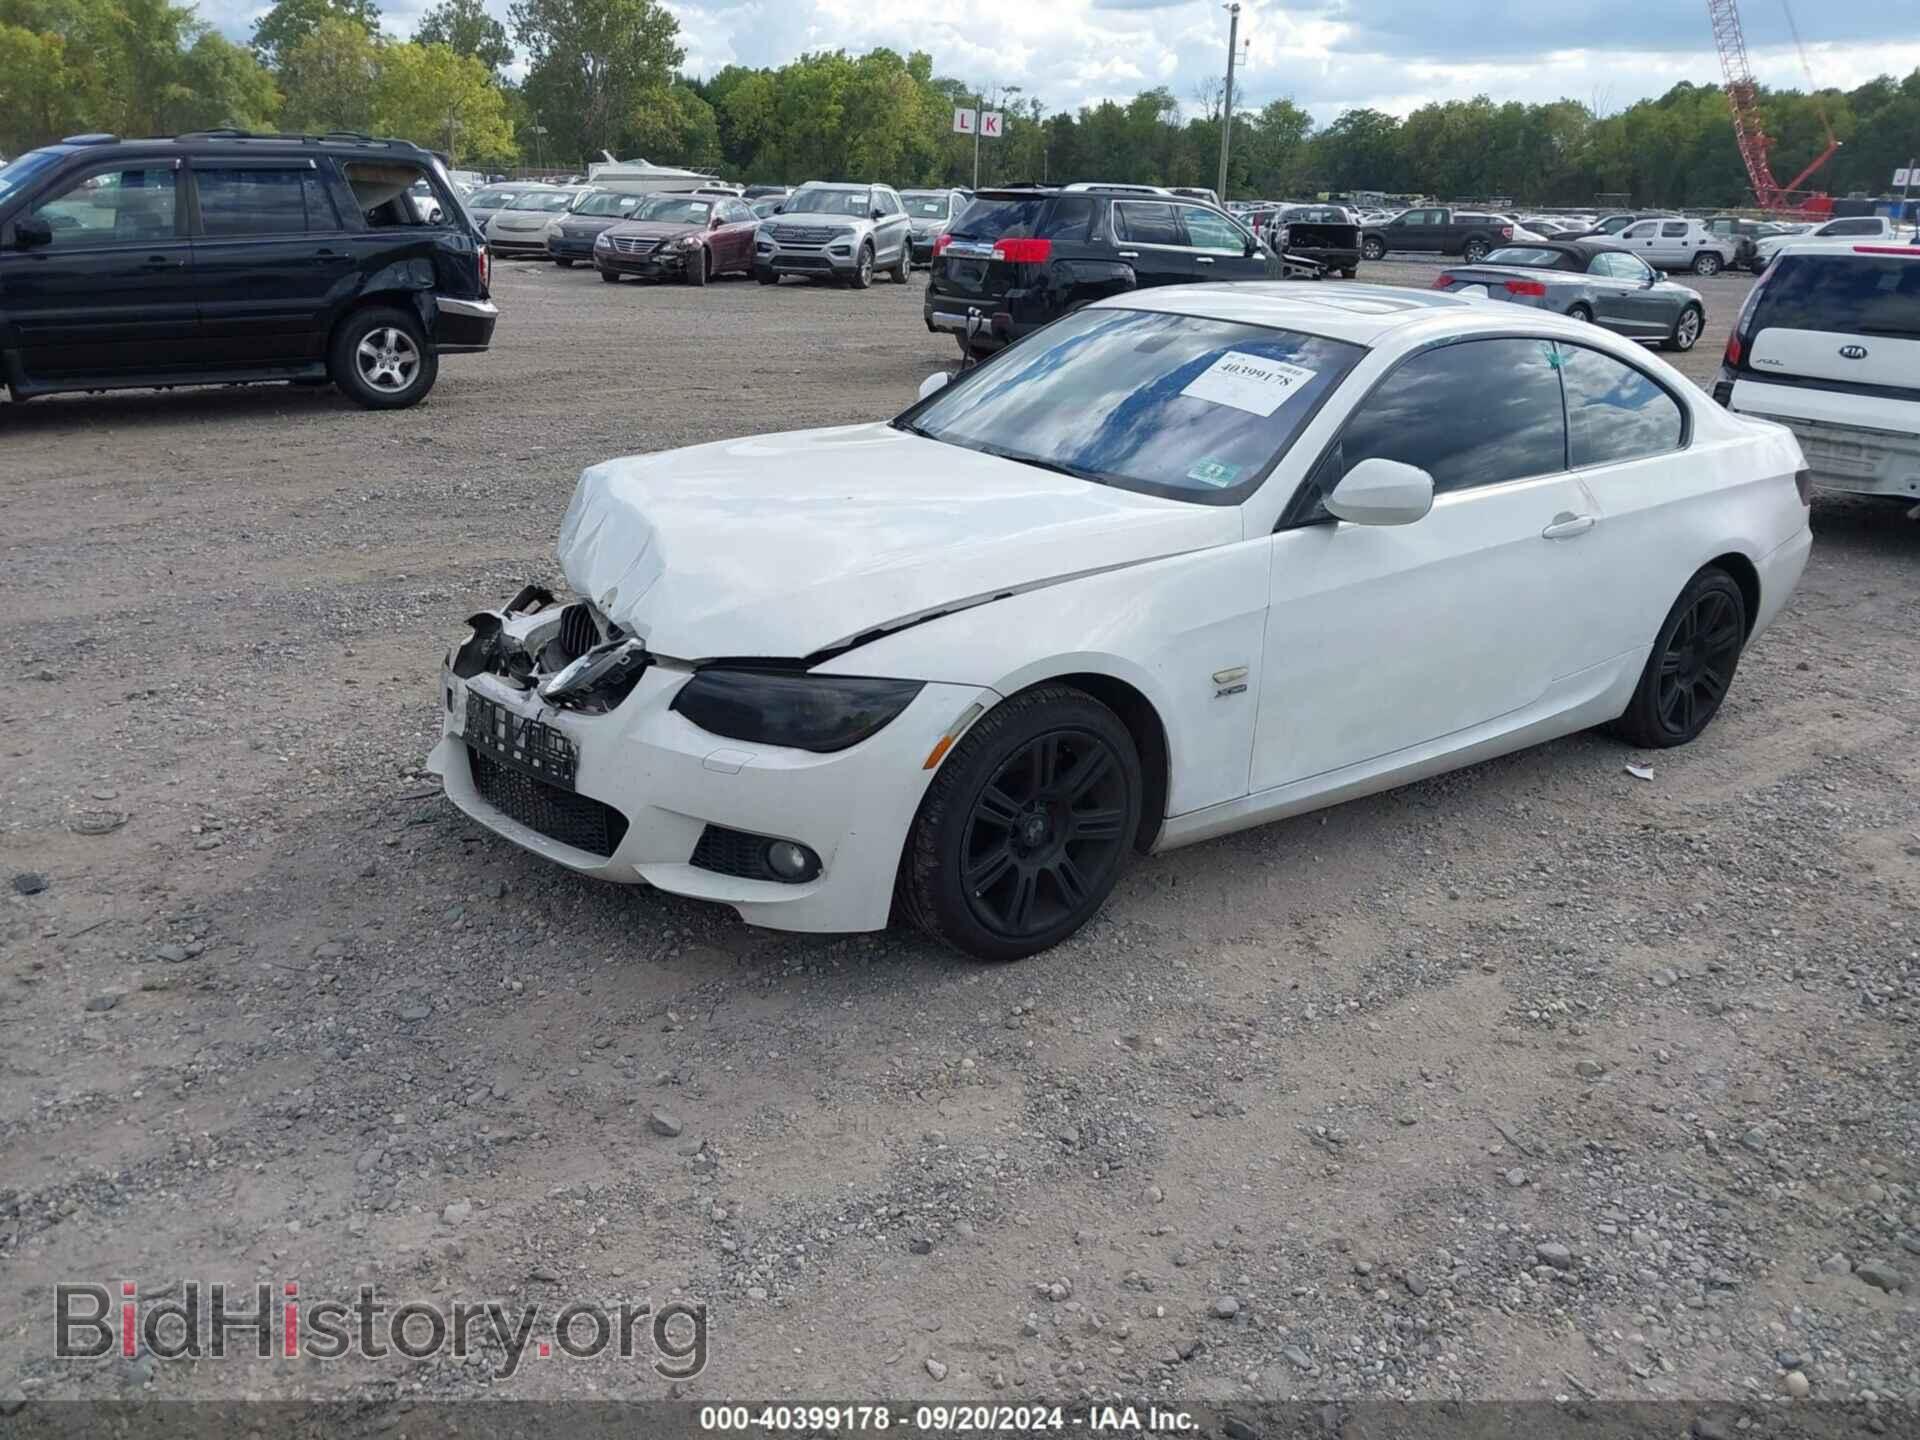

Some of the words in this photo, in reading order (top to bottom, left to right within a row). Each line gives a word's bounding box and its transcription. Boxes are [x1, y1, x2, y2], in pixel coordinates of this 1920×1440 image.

[960, 113, 969, 129] L
[986, 116, 996, 132] K
[1841, 346, 1865, 358] KIA
[1220, 362, 1293, 386] 40399178
